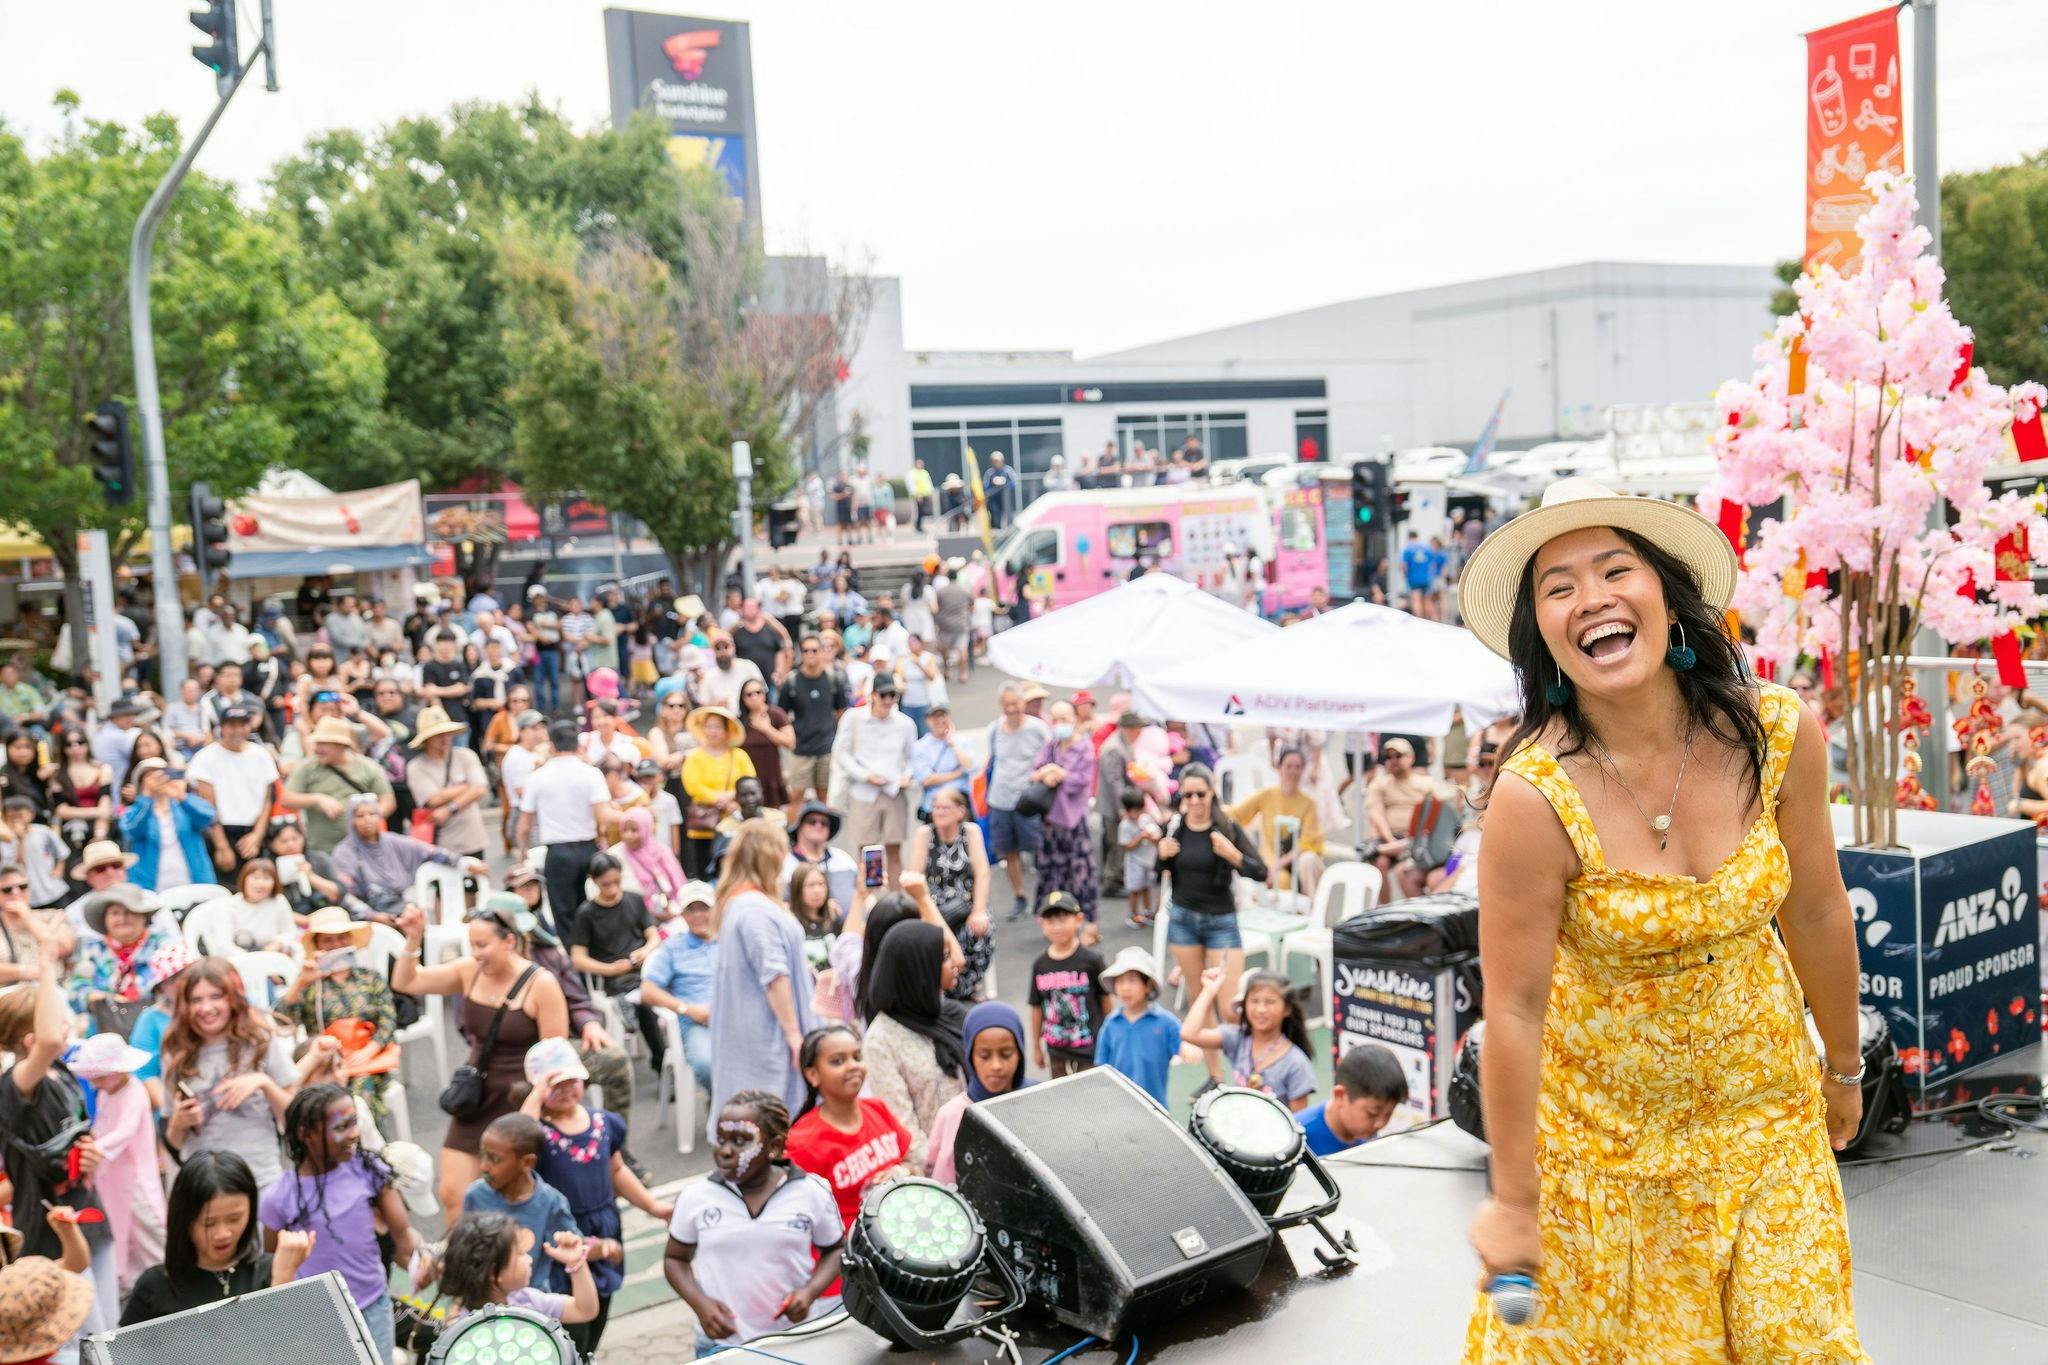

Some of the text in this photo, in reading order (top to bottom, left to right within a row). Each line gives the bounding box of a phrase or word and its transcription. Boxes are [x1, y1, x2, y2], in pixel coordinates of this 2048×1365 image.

[651, 78, 728, 107] Sunshine
[1254, 693, 1366, 713] ADV Partners
[1933, 888, 1996, 948] ANZ
[1334, 963, 1434, 1001] Sunshine
[1929, 943, 2034, 1000] PROUD SPONSOR
[1345, 1016, 1425, 1048] OUR SPONSORS
[1347, 1003, 1422, 1034] THANK YOU TO
